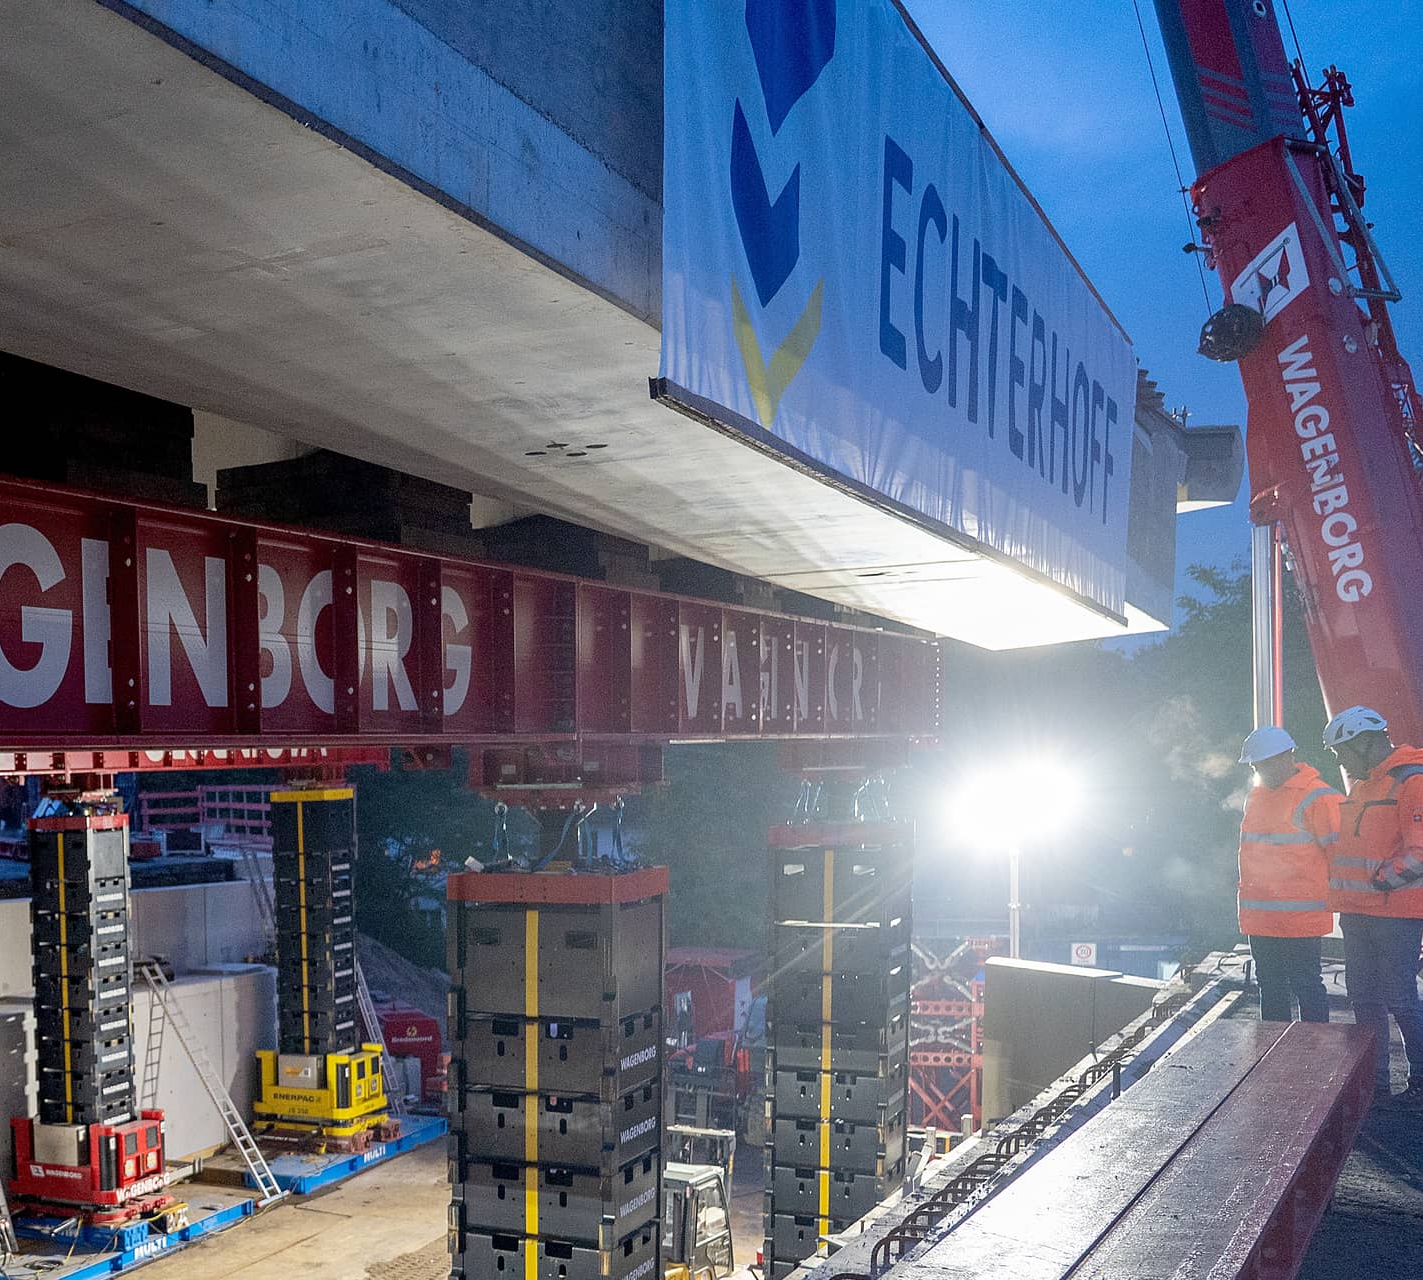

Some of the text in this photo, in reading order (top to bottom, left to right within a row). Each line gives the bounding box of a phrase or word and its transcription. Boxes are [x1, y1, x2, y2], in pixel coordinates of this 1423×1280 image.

[880, 134, 1118, 525] ECHTERHOFF
[1277, 334, 1373, 603] WAGENBORG
[620, 1045, 657, 1072] WAGENBORG
[620, 1116, 656, 1144] WAGENBORG
[363, 1146, 386, 1163] MULTI
[619, 1187, 656, 1217] WAGENBORG
[134, 1237, 168, 1260] MULTI
